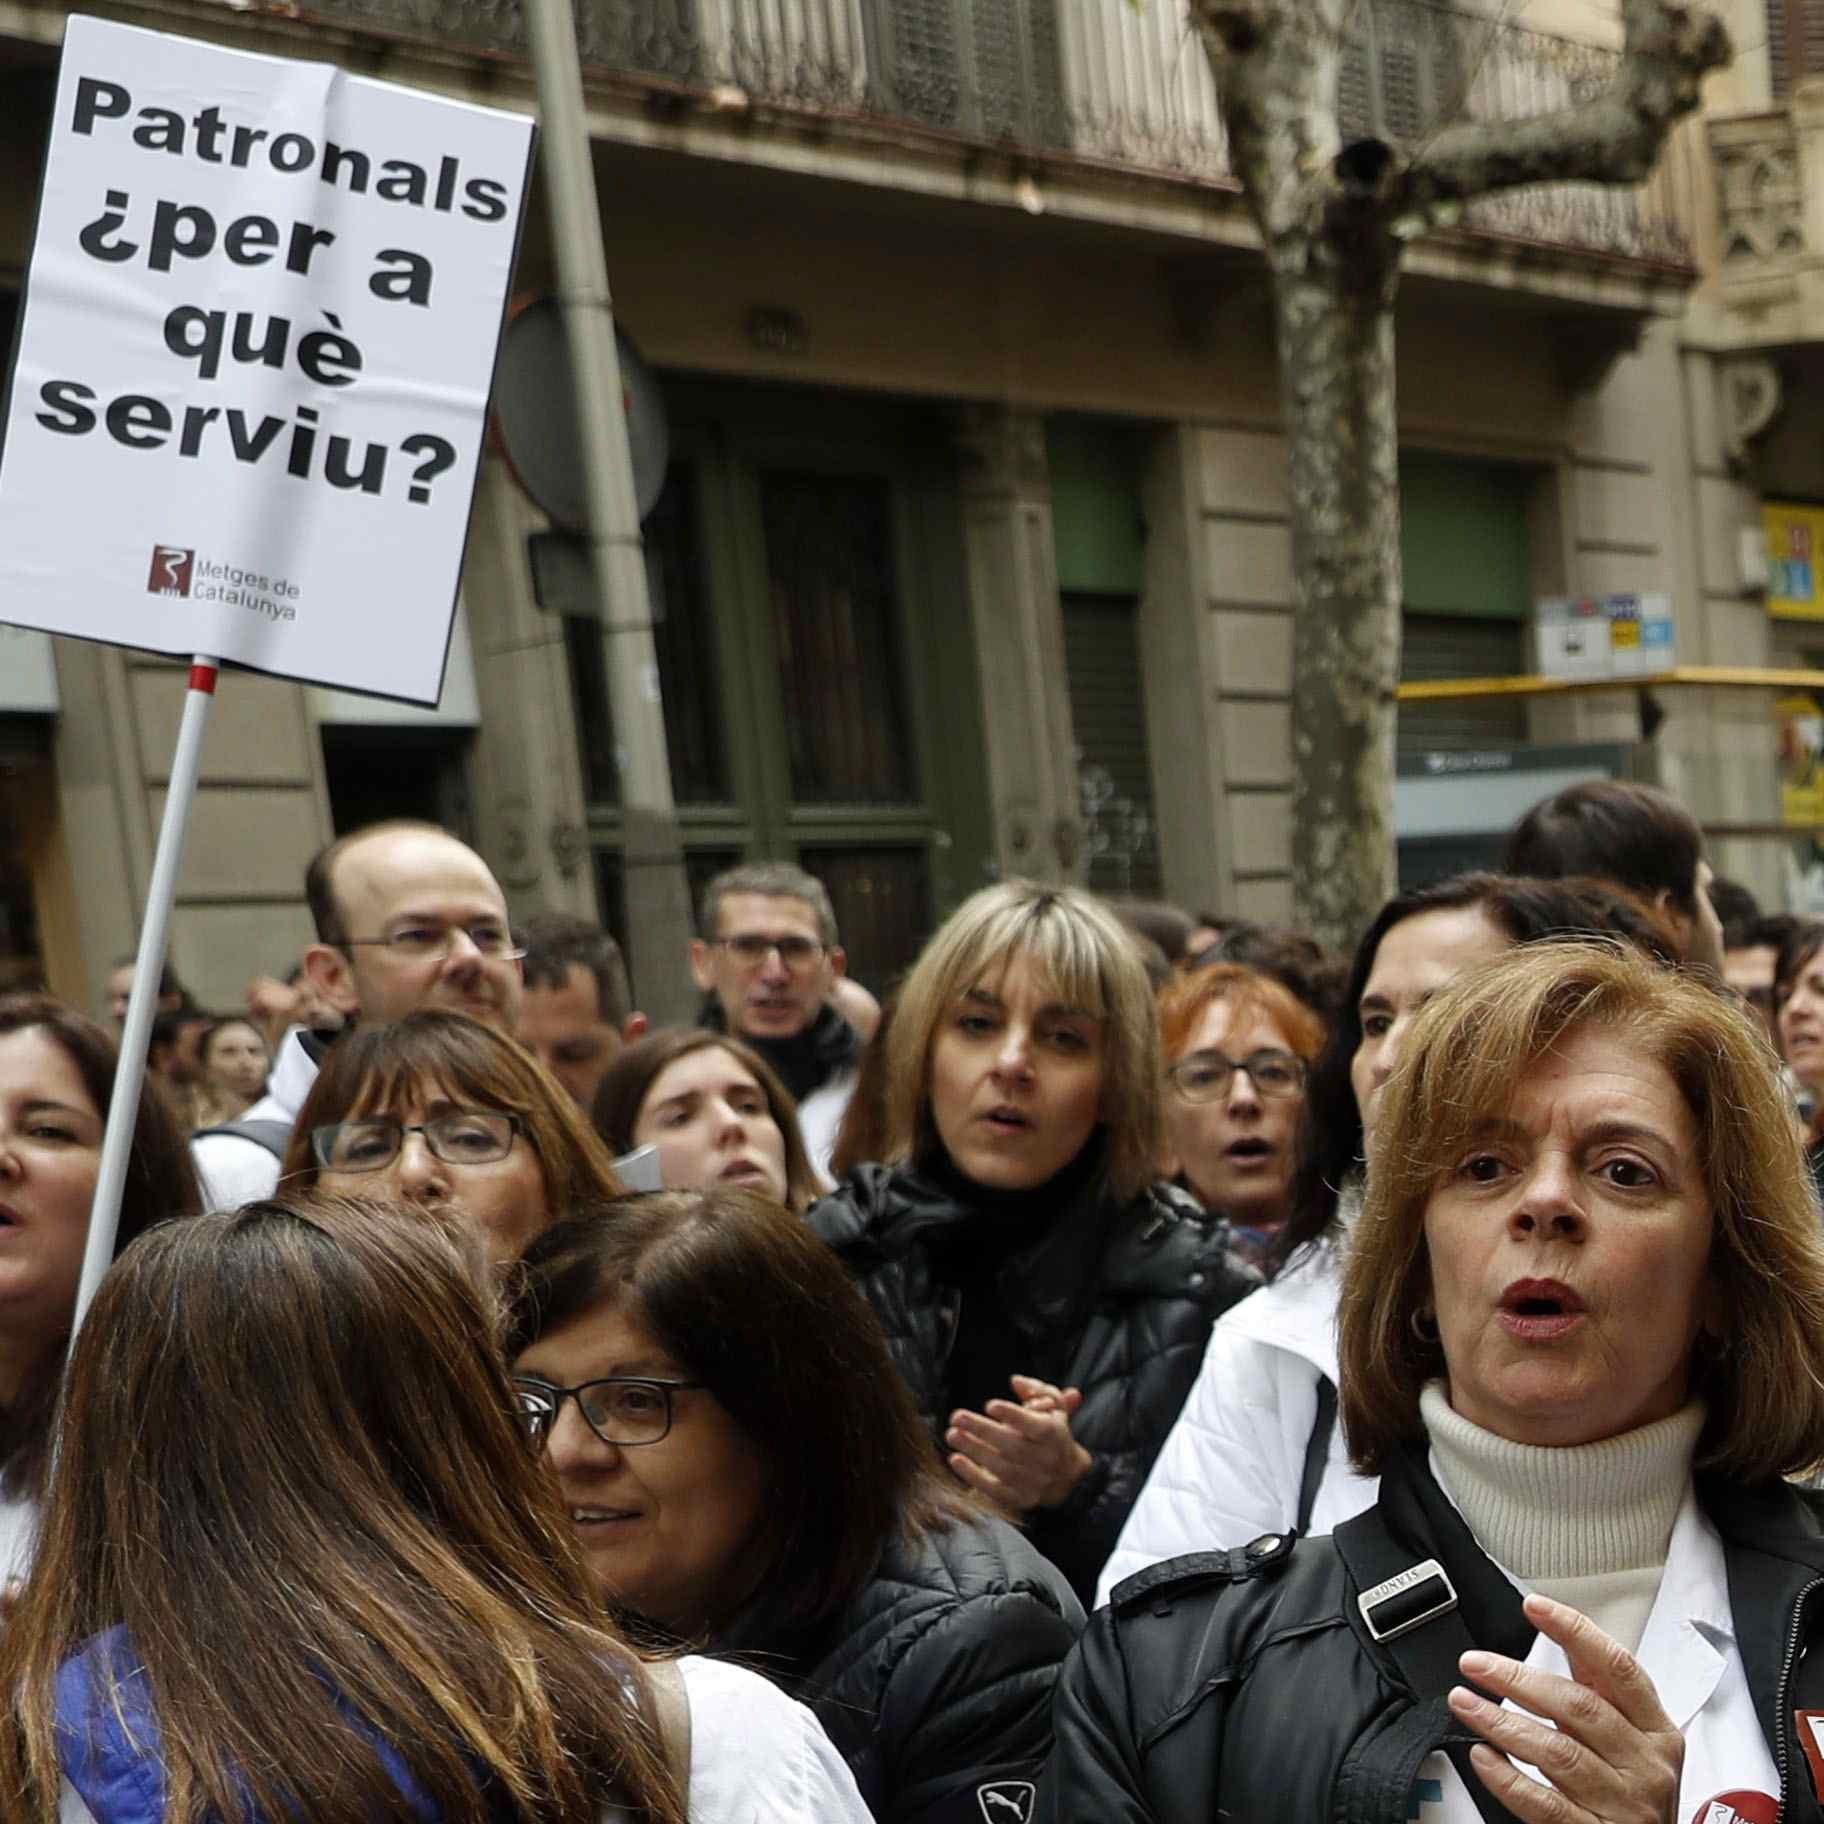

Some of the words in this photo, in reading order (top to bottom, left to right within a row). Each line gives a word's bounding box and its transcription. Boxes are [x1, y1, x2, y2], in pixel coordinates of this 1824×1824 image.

[71, 76, 508, 223] Patronals
[79, 189, 335, 276] ¿per
[368, 248, 434, 308] a
[164, 304, 363, 388] què
[35, 379, 456, 505] serviu?
[193, 582, 296, 621] Catalunya
[196, 560, 268, 591] Metges
[274, 580, 300, 599] de
